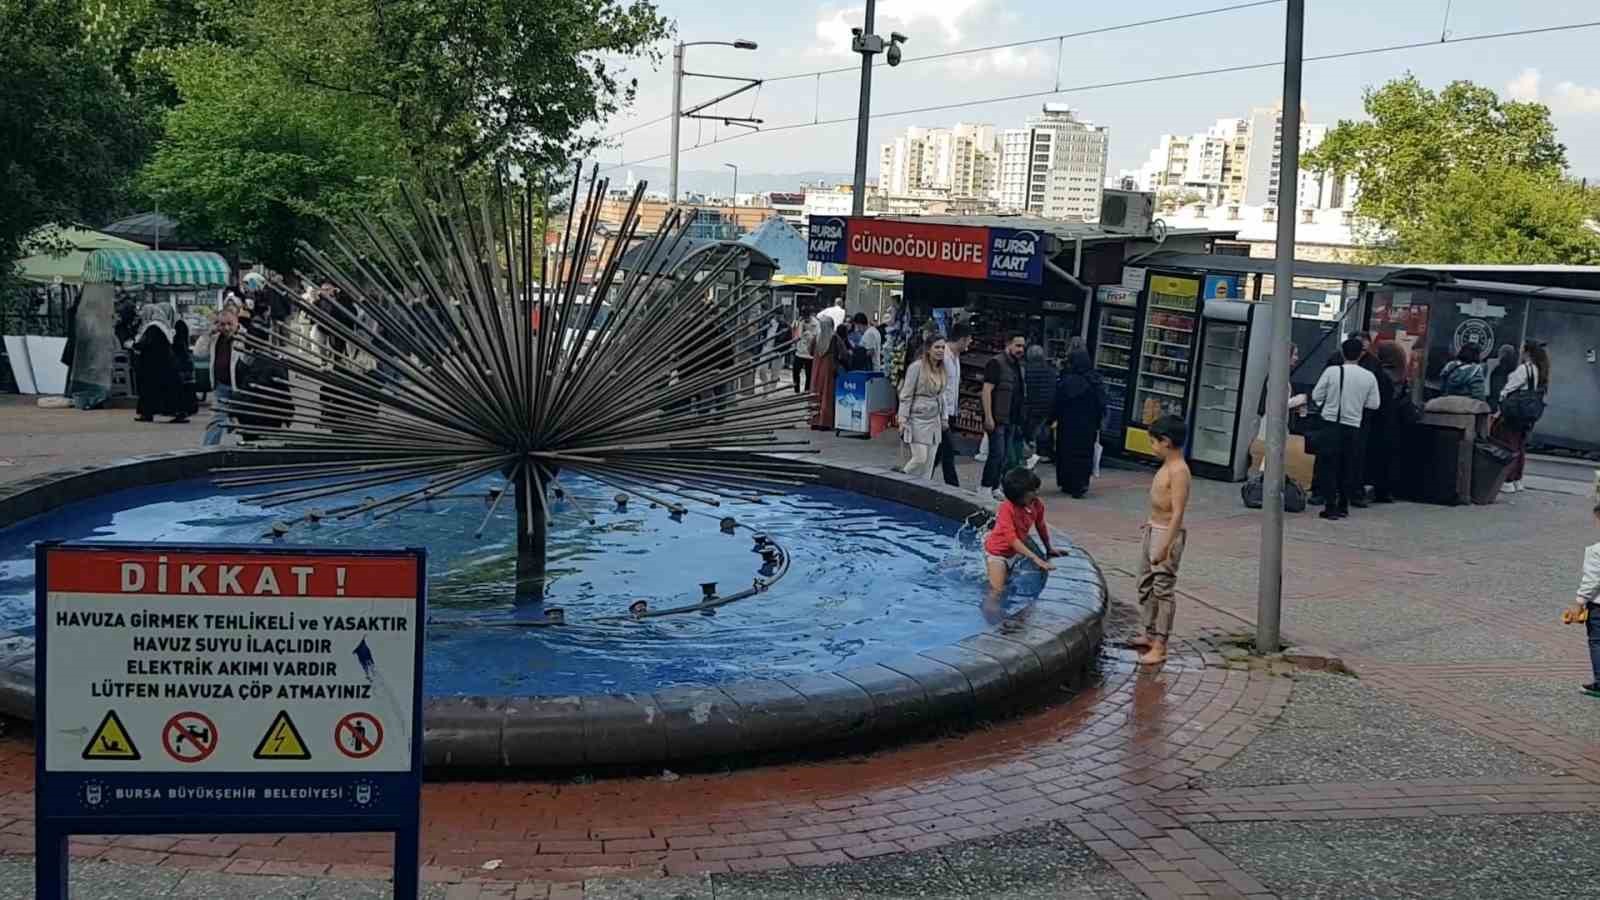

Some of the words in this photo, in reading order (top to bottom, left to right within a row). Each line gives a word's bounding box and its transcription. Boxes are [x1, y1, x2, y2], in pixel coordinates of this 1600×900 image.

[811, 225, 842, 239] BURSA
[810, 239, 837, 252] KART
[852, 231, 937, 258] GÜNDOĞDU
[941, 237, 982, 263] BÜFE
[993, 238, 1035, 255] BURSA
[992, 255, 1029, 271] KART
[121, 556, 315, 595] DİKKAT
[56, 611, 126, 628] HAVUZA
[131, 609, 199, 629] GİRMEK
[204, 612, 294, 630] TEHLİKELİ
[299, 619, 318, 631] ve
[323, 616, 407, 631] YASAKTIR
[133, 637, 191, 652] HAVUZ
[195, 638, 242, 653] SUYU
[247, 635, 332, 655] İLAÇLIDIR
[127, 657, 213, 675] ELEKTRİK
[218, 661, 268, 676] AKIMI
[273, 661, 337, 677] VARDIR
[91, 679, 159, 697] LÜTFEN
[164, 683, 233, 698] HAVUZA
[238, 681, 273, 701] ÇÖP
[276, 684, 371, 699] ATMAYINIZ
[115, 788, 161, 798] BURSA
[168, 786, 256, 800] BÜYÜKŞEHİR
[264, 786, 343, 798] BELEDİYESİ
